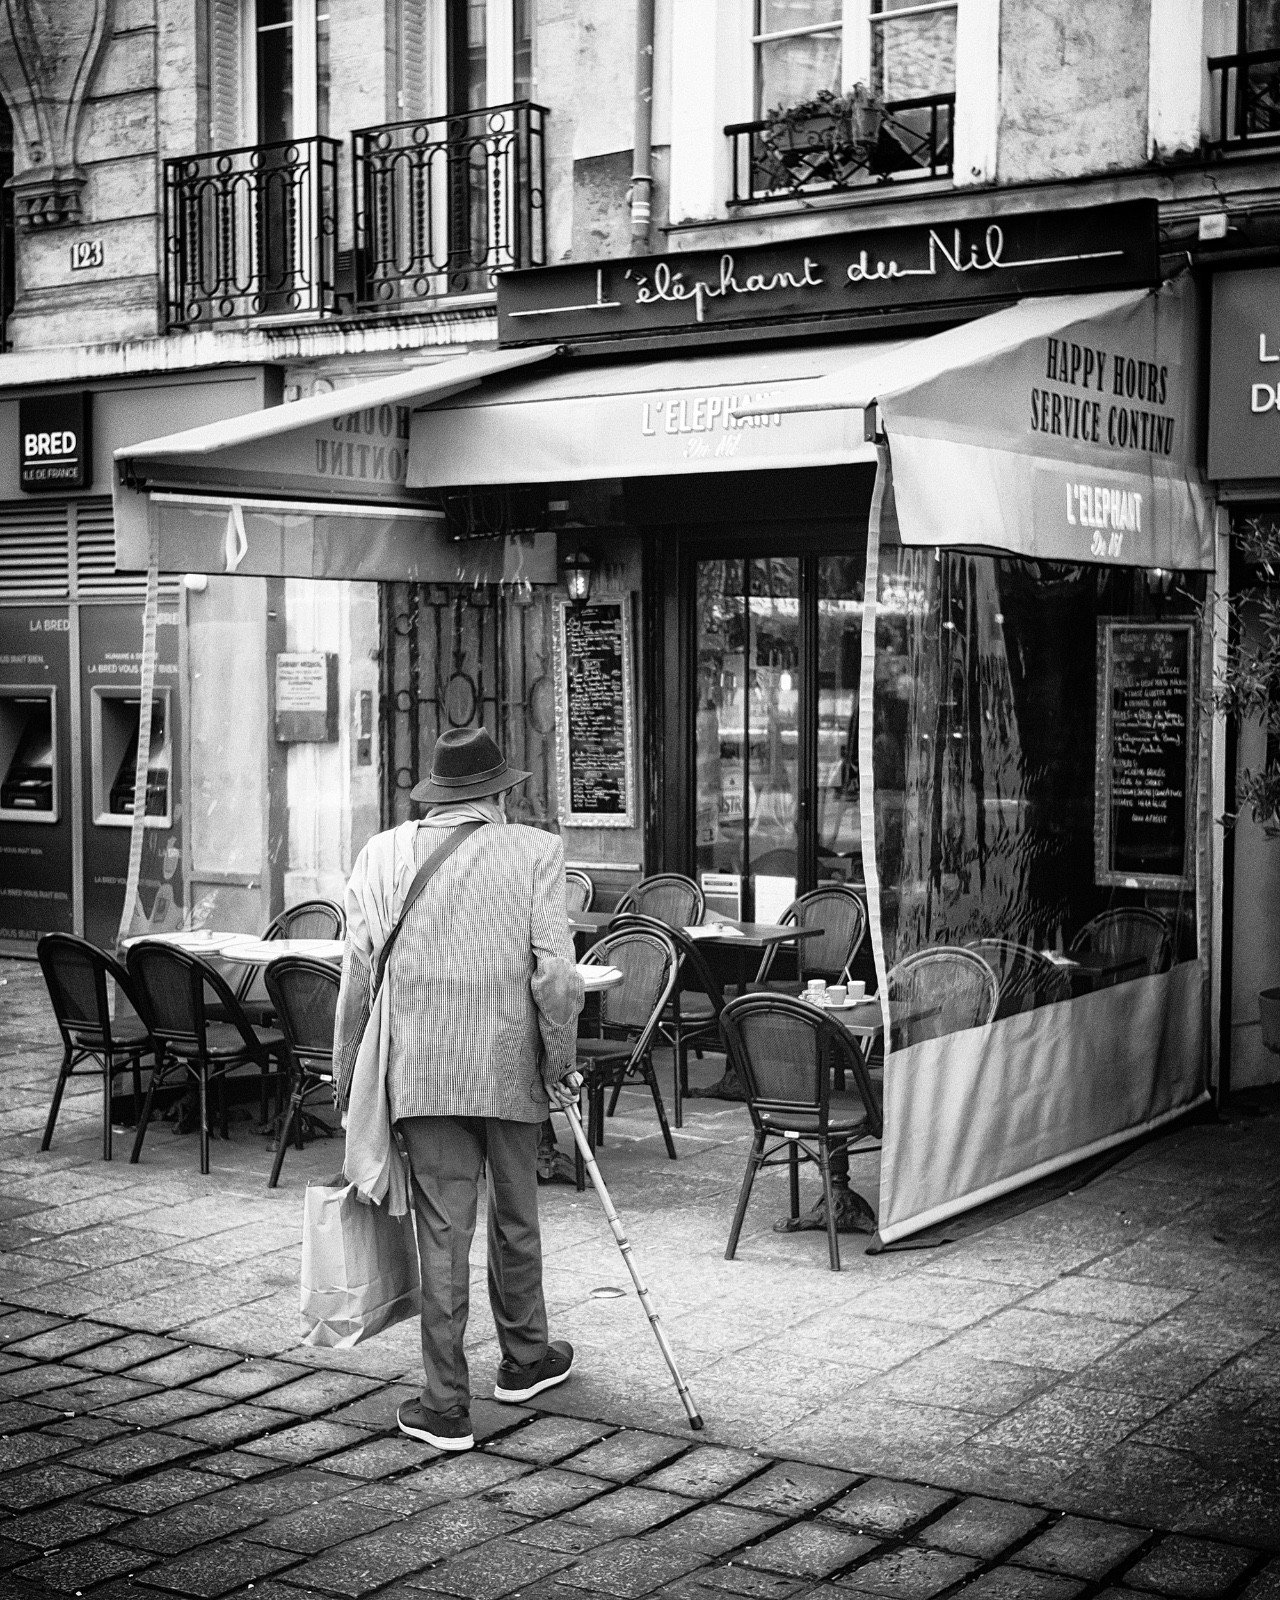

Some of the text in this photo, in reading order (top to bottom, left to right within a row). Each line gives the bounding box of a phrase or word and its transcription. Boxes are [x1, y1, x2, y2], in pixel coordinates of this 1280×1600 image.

[71, 241, 104, 270] 123
[847, 250, 905, 281] du
[928, 224, 1004, 271] Nil
[1046, 336, 1168, 405] HAPPY HOURS
[1030, 387, 1175, 455] SERVICE CONTINU
[25, 431, 77, 456] BRED
[36, 469, 47, 479] DE
[48, 467, 78, 478] FRANCE
[1066, 483, 1143, 533] L'ELEPHANT
[30, 619, 70, 631] LA BRED
